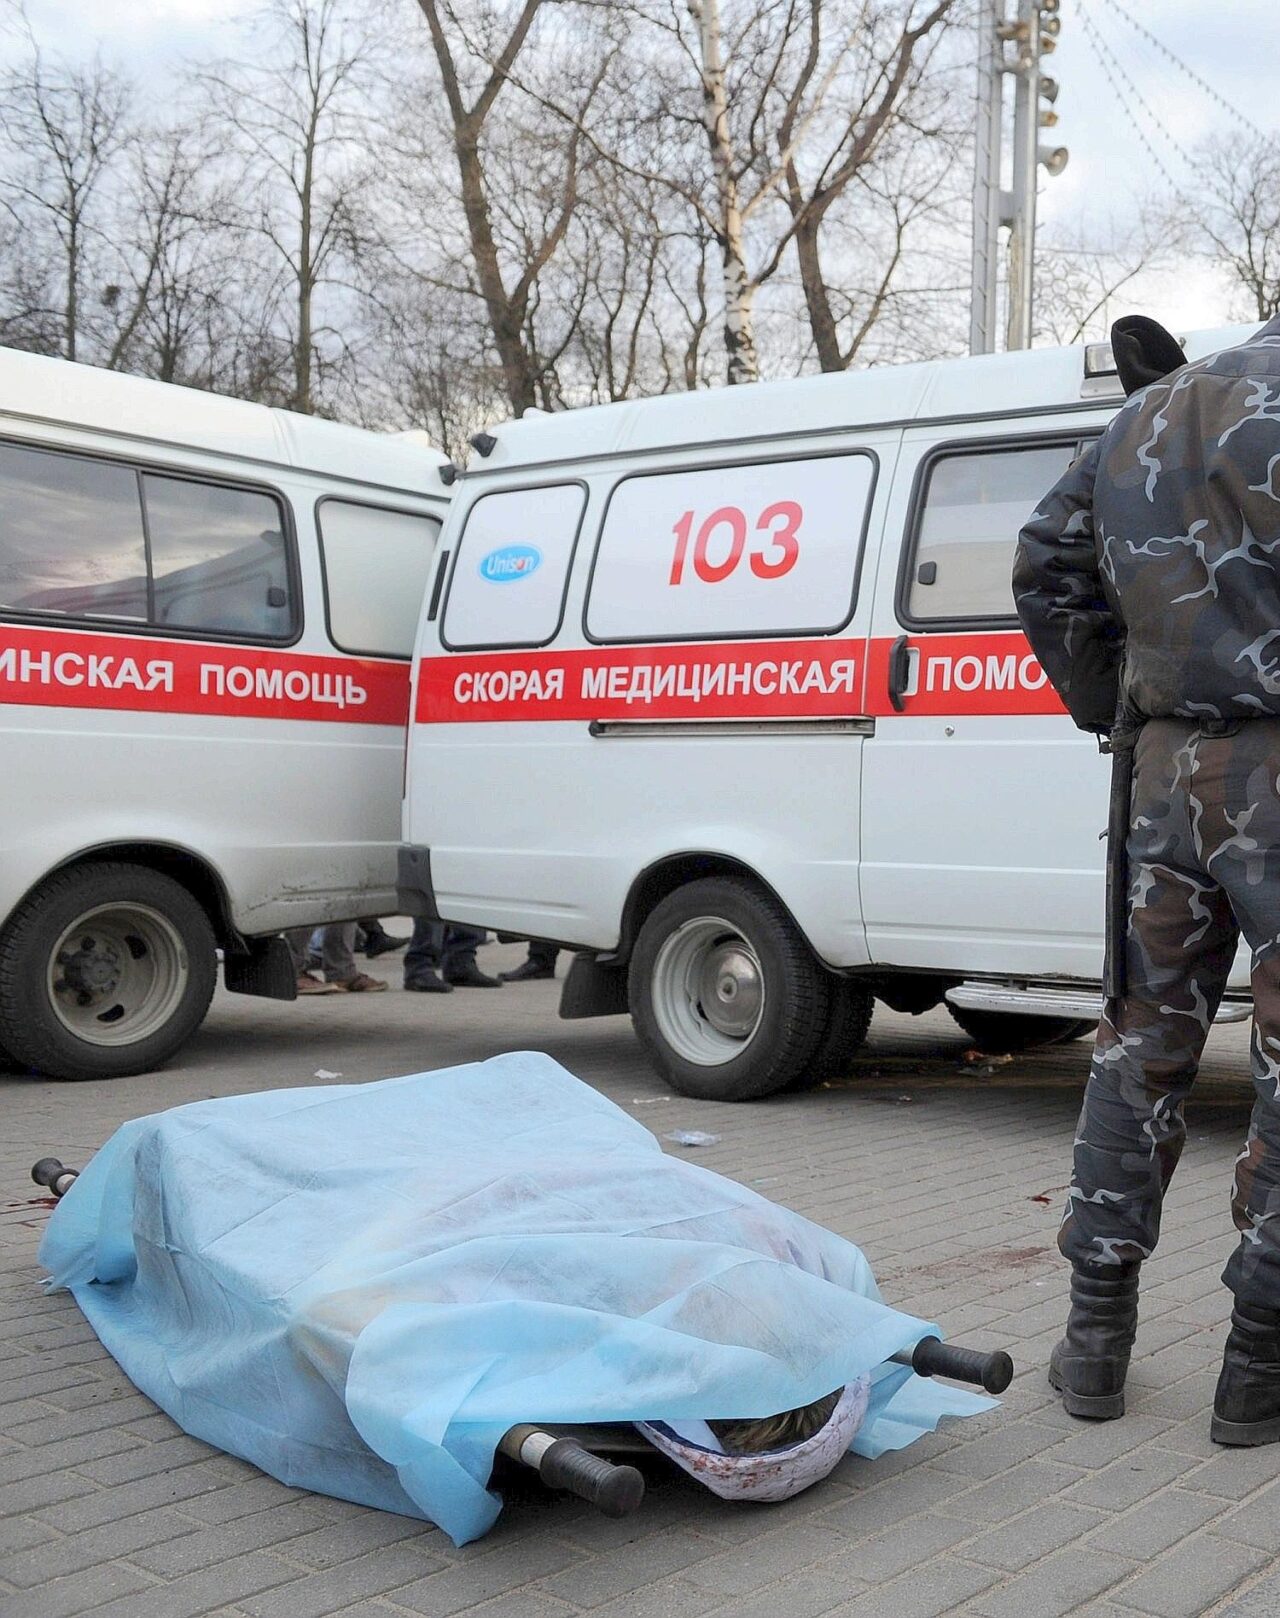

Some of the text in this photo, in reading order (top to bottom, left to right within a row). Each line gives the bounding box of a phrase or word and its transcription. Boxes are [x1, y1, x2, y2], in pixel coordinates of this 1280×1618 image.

[669, 501, 804, 585] 103
[200, 664, 367, 709] ПОМОЩЬ
[454, 655, 1052, 704] СКОРАЯ МЕДИЦИНСКАЯ ПОМО
